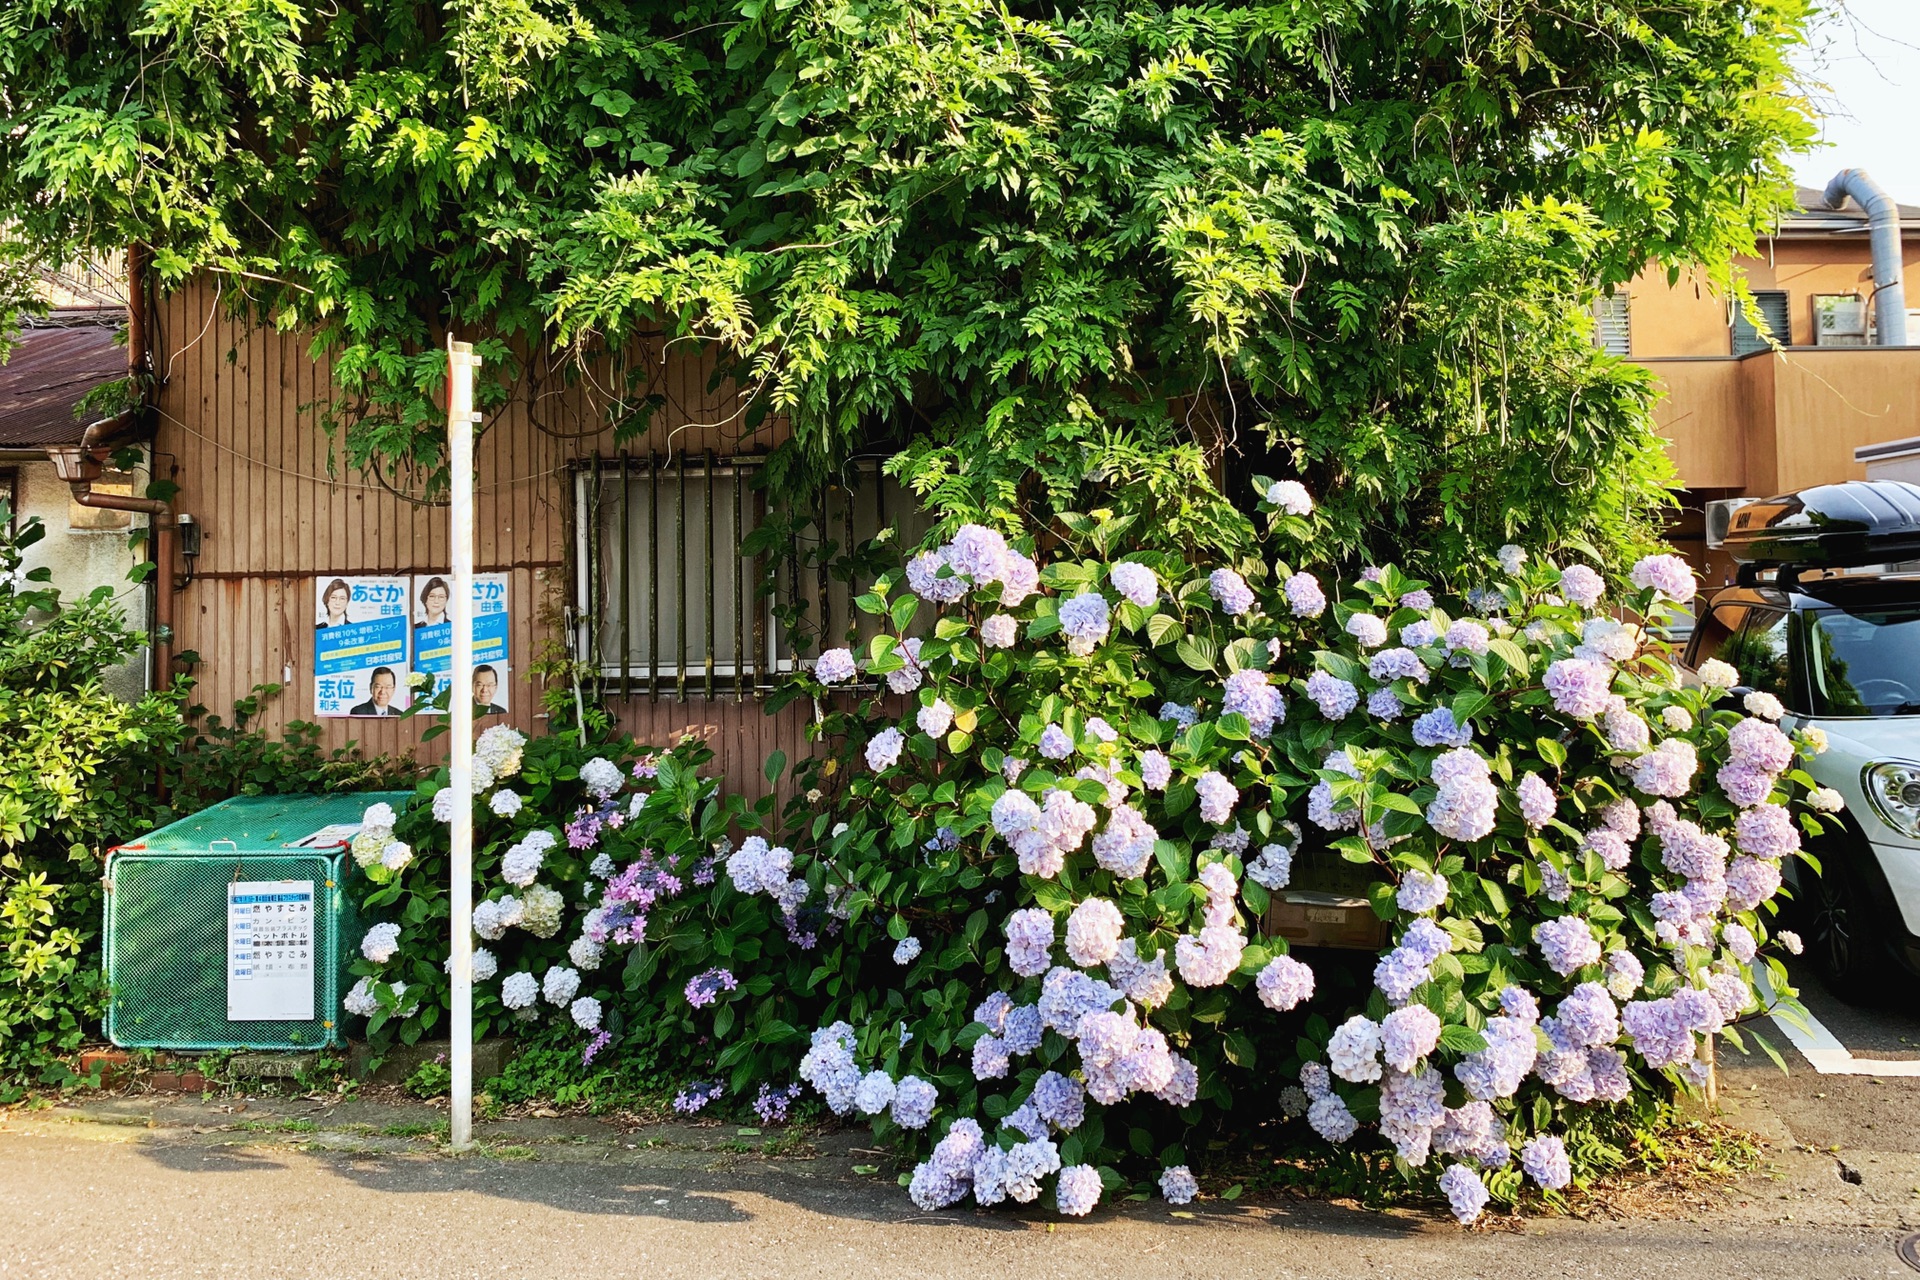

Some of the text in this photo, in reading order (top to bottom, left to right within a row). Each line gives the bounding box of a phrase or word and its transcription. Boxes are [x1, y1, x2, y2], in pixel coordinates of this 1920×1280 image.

[351, 584, 405, 603] あさか
[472, 581, 505, 600] さか
[380, 603, 403, 615] 由香
[480, 600, 504, 613] 由香
[420, 628, 451, 641] 消費税10
[365, 651, 403, 666] 日本共産党
[472, 649, 504, 662] 本共産党
[318, 678, 355, 699] 志位
[319, 700, 340, 711] 和夫
[252, 932, 307, 940] ペットボトル
[234, 968, 252, 976] 金曜日
